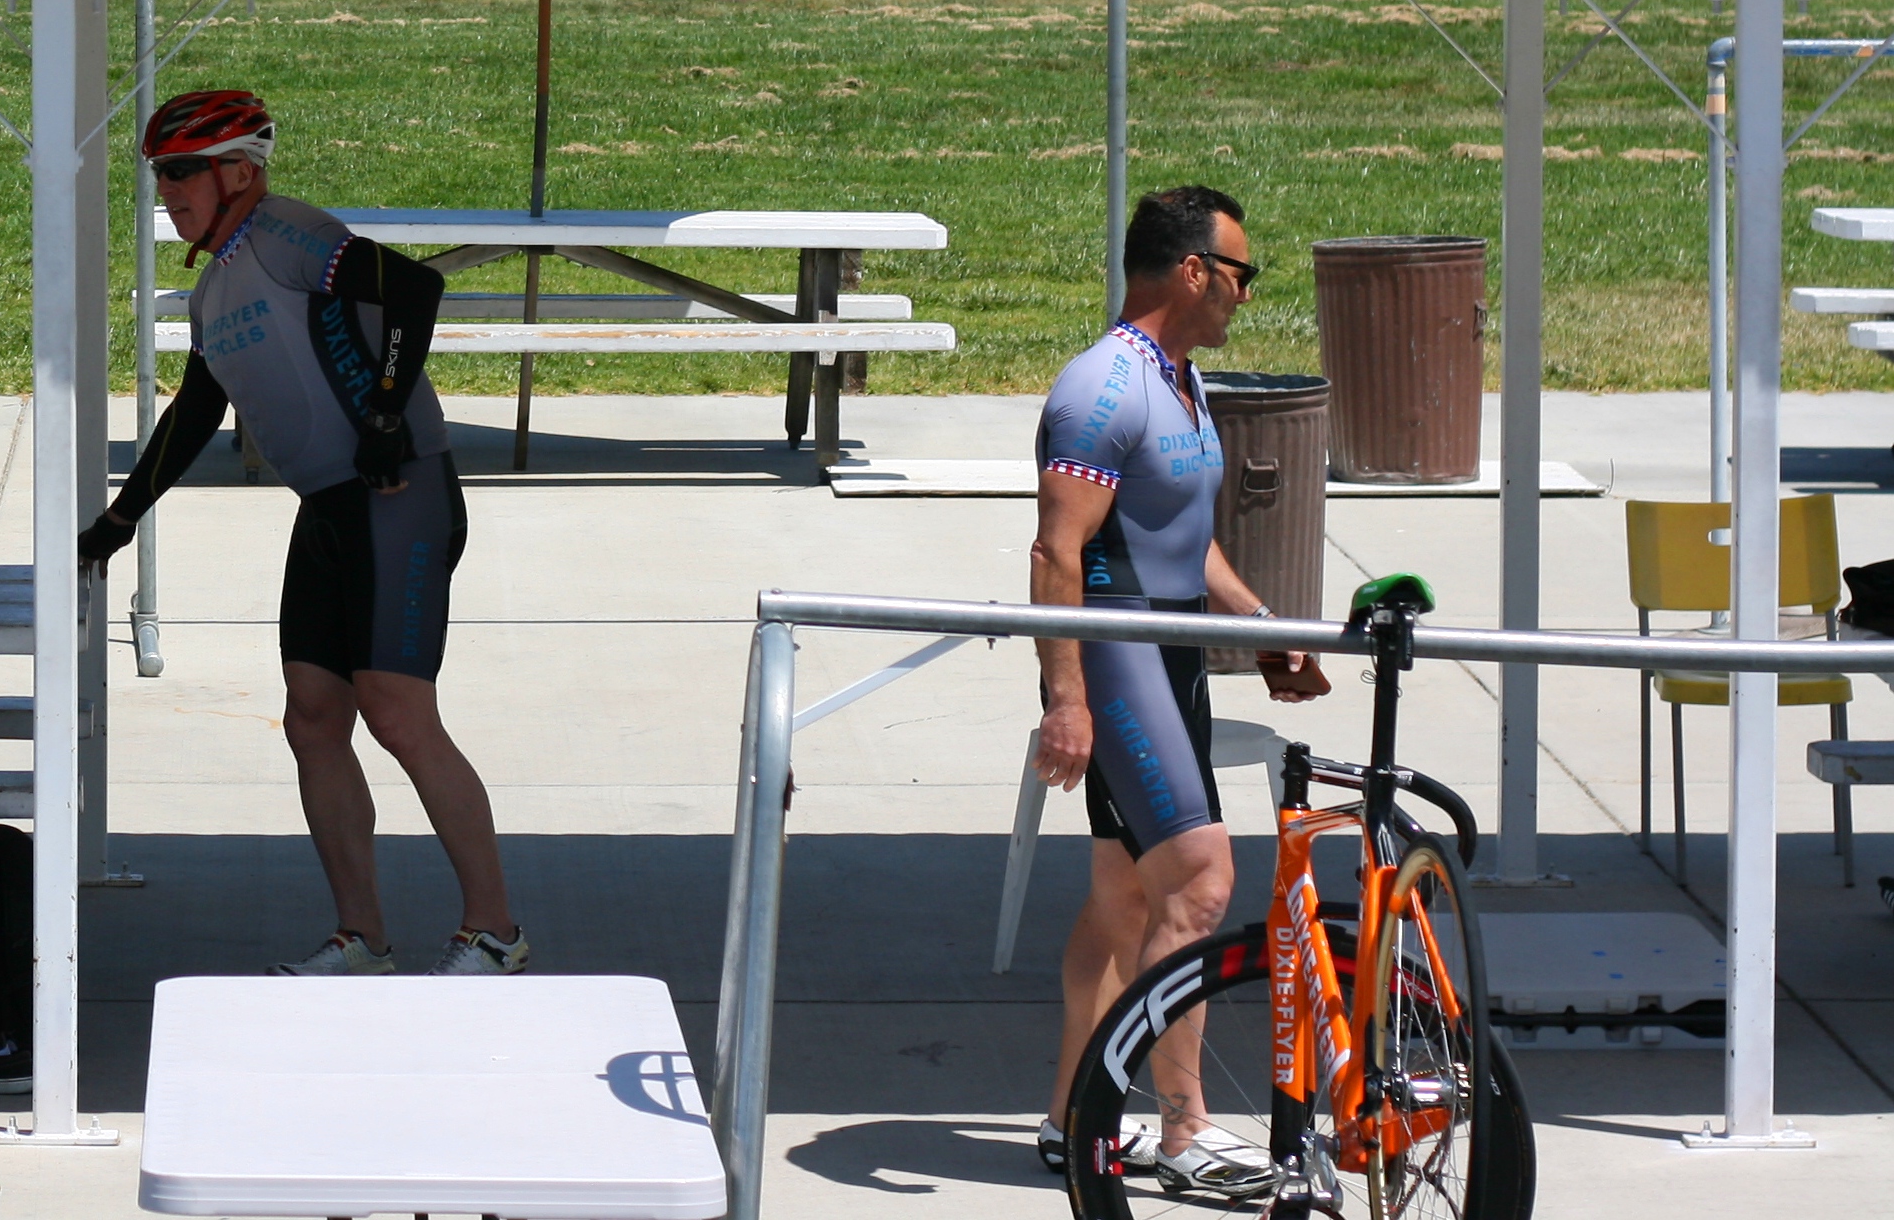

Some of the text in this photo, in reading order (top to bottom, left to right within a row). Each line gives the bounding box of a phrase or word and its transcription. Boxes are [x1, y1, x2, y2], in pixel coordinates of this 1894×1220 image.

[321, 296, 362, 375] DIXIE
[385, 327, 402, 378] SKINS
[1073, 353, 1133, 454] DIXIE FLYER
[1157, 430, 1201, 454] DIXIE
[1102, 697, 1176, 823] DIXIE FLYER
[1275, 926, 1296, 1085] DIXIE FLYER
[1288, 892, 1337, 1074] DIXIE FLYER
